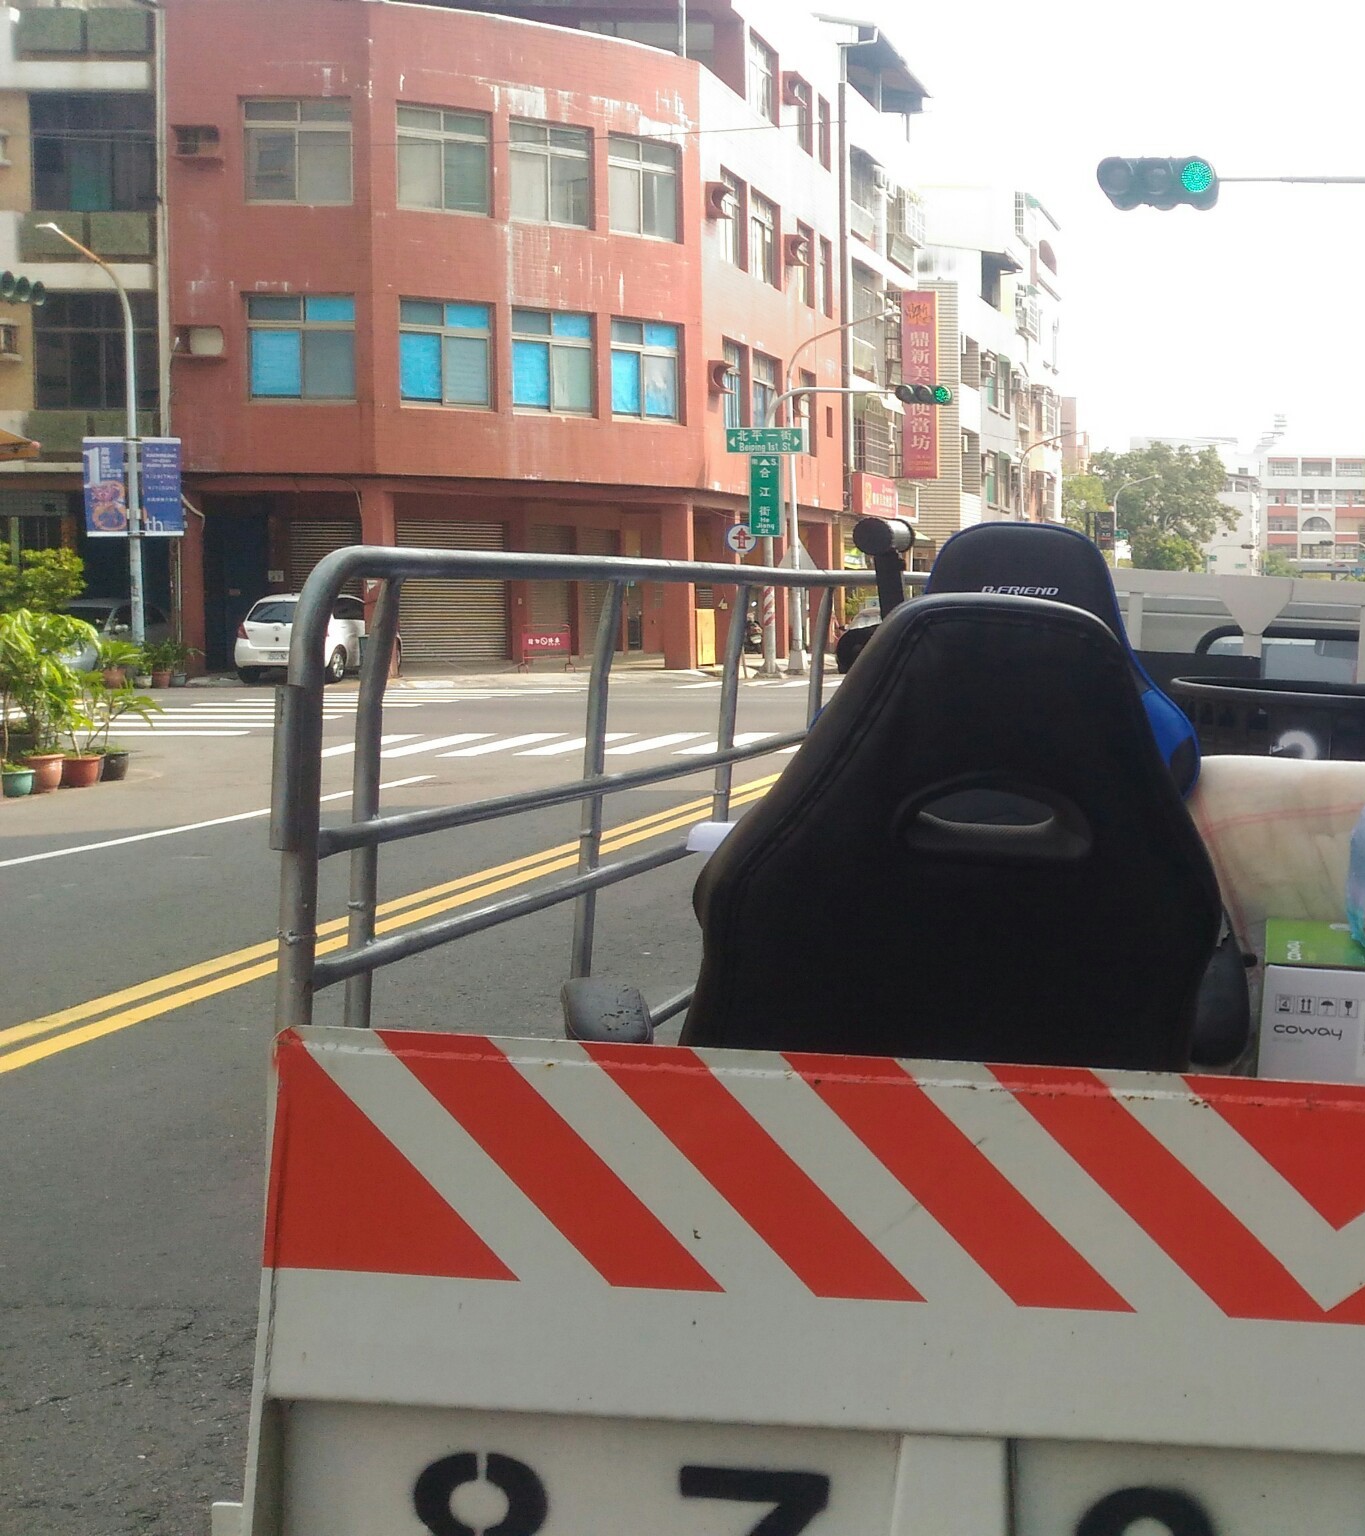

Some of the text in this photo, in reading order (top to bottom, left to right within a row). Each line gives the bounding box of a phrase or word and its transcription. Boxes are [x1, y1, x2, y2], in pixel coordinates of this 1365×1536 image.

[910, 331, 931, 450] 鼎新美便當坊
[737, 429, 792, 442] 北平一街
[739, 442, 766, 452] Beiping
[767, 442, 778, 451] 1st
[759, 467, 771, 516] 合江街
[1273, 1024, 1343, 1041] coway
